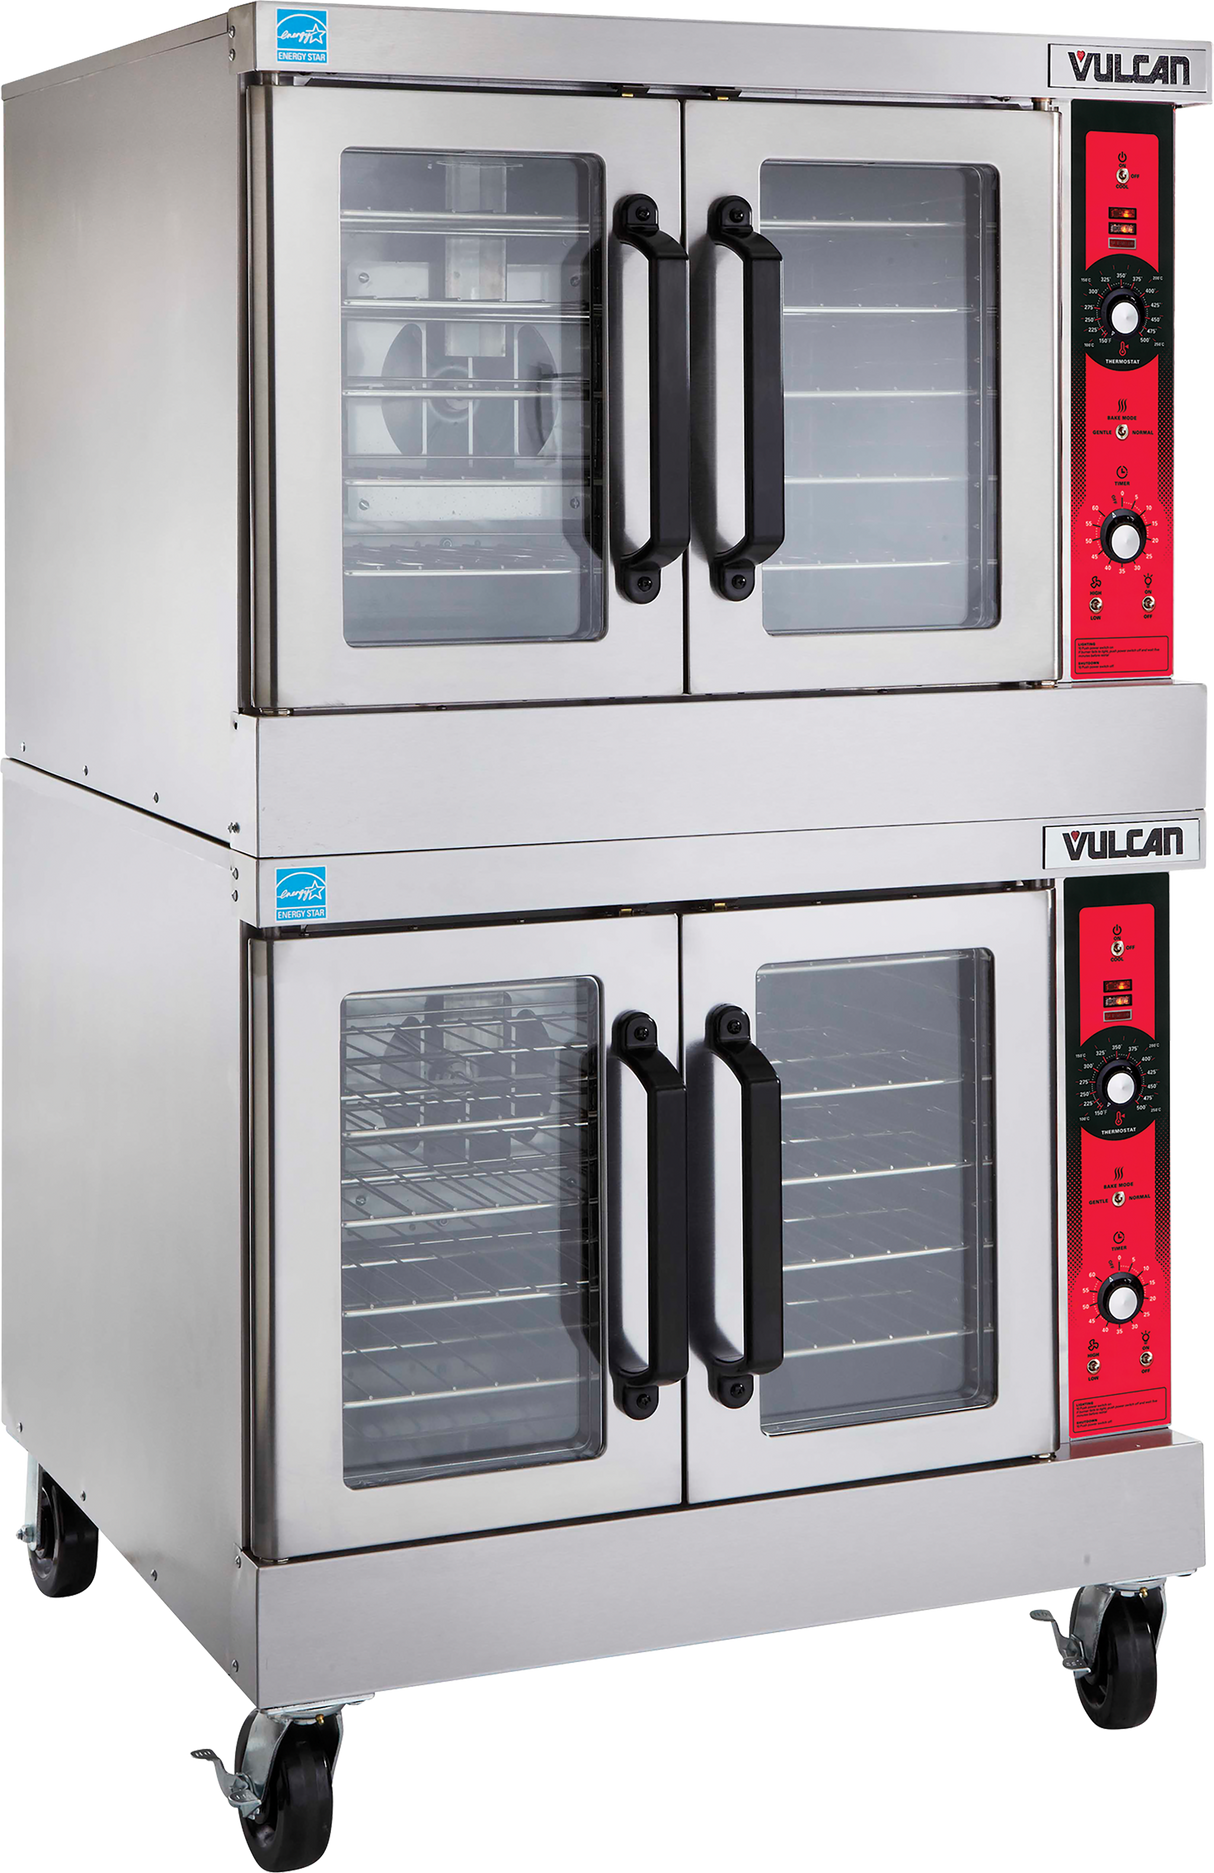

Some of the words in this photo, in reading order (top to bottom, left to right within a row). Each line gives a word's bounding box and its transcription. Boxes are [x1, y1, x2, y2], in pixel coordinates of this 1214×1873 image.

[278, 52, 306, 60] ENERGY
[308, 53, 326, 61] STAR
[1067, 50, 1190, 85] VULCAN
[1062, 826, 1184, 861] VULCAN
[278, 910, 305, 919] ENERGY
[306, 909, 324, 917] STAR
[1101, 1127, 1136, 1135] THERMOSTAT
